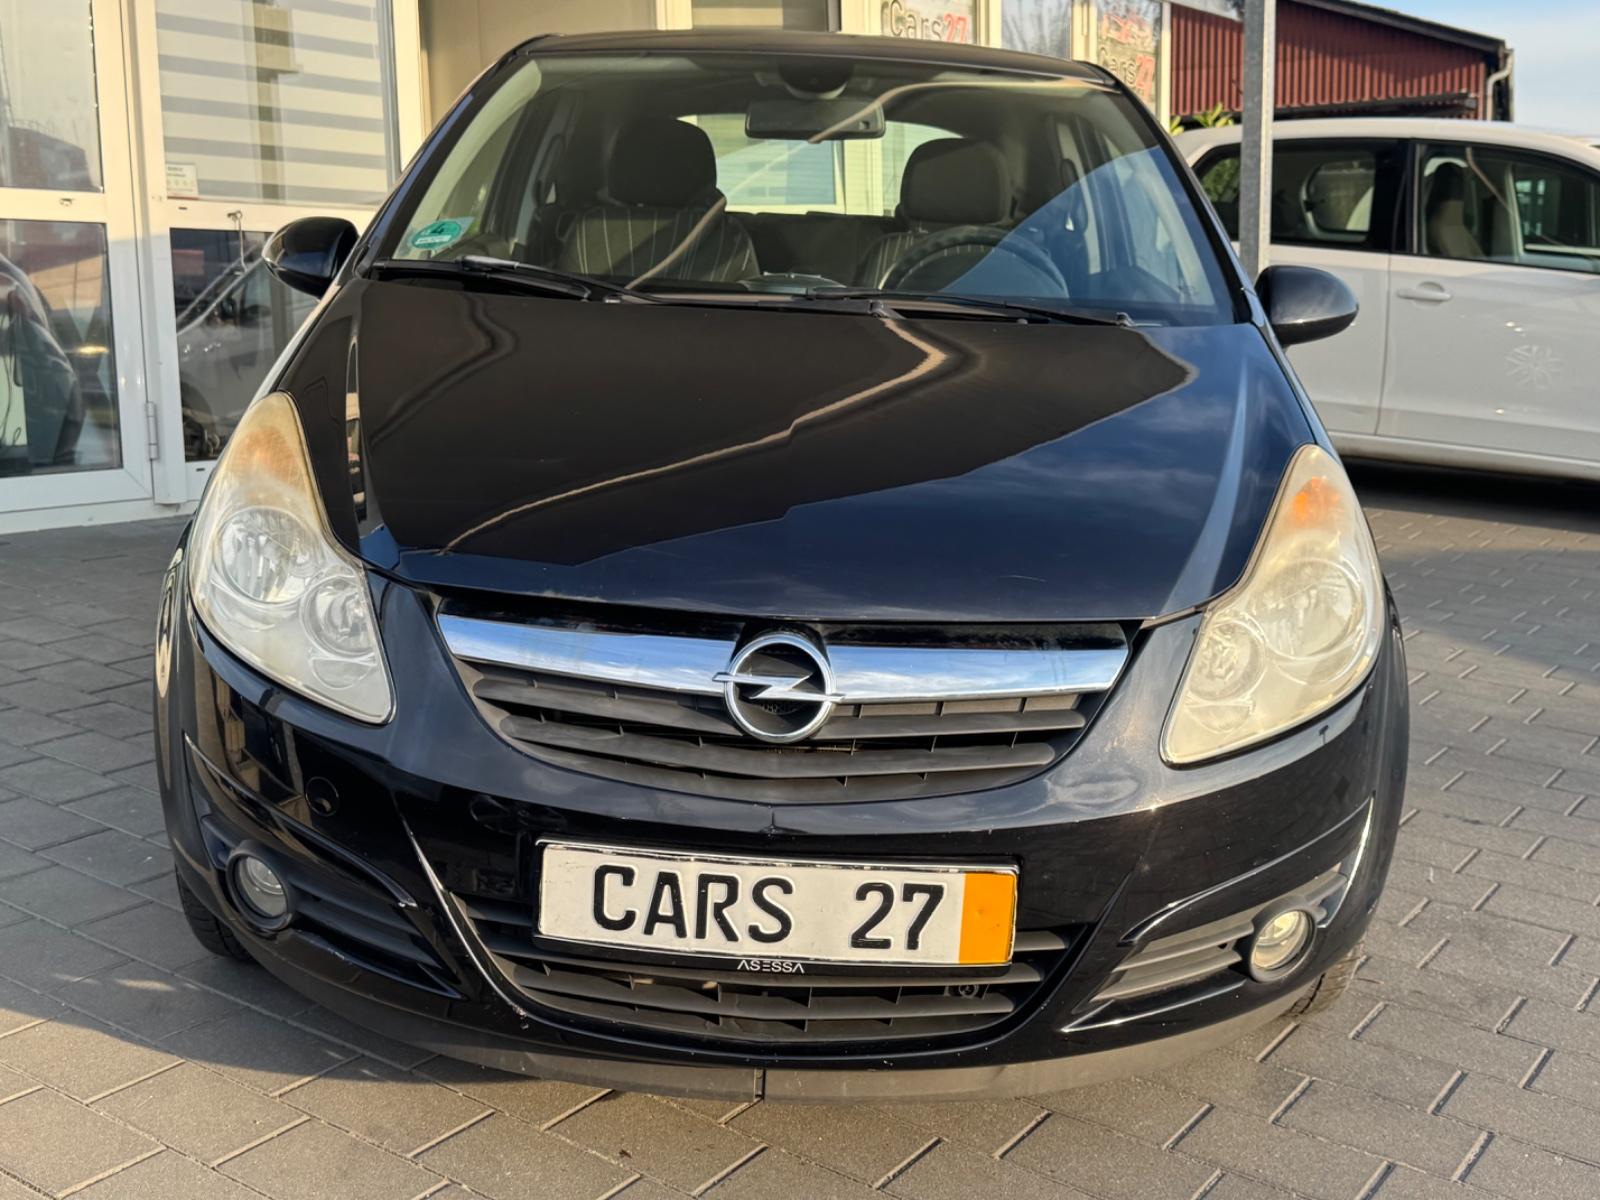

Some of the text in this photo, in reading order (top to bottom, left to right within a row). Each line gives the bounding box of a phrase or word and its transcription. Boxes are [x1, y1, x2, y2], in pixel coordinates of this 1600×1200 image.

[593, 863, 945, 951] CARS 27
[737, 959, 805, 974] ASESSA
